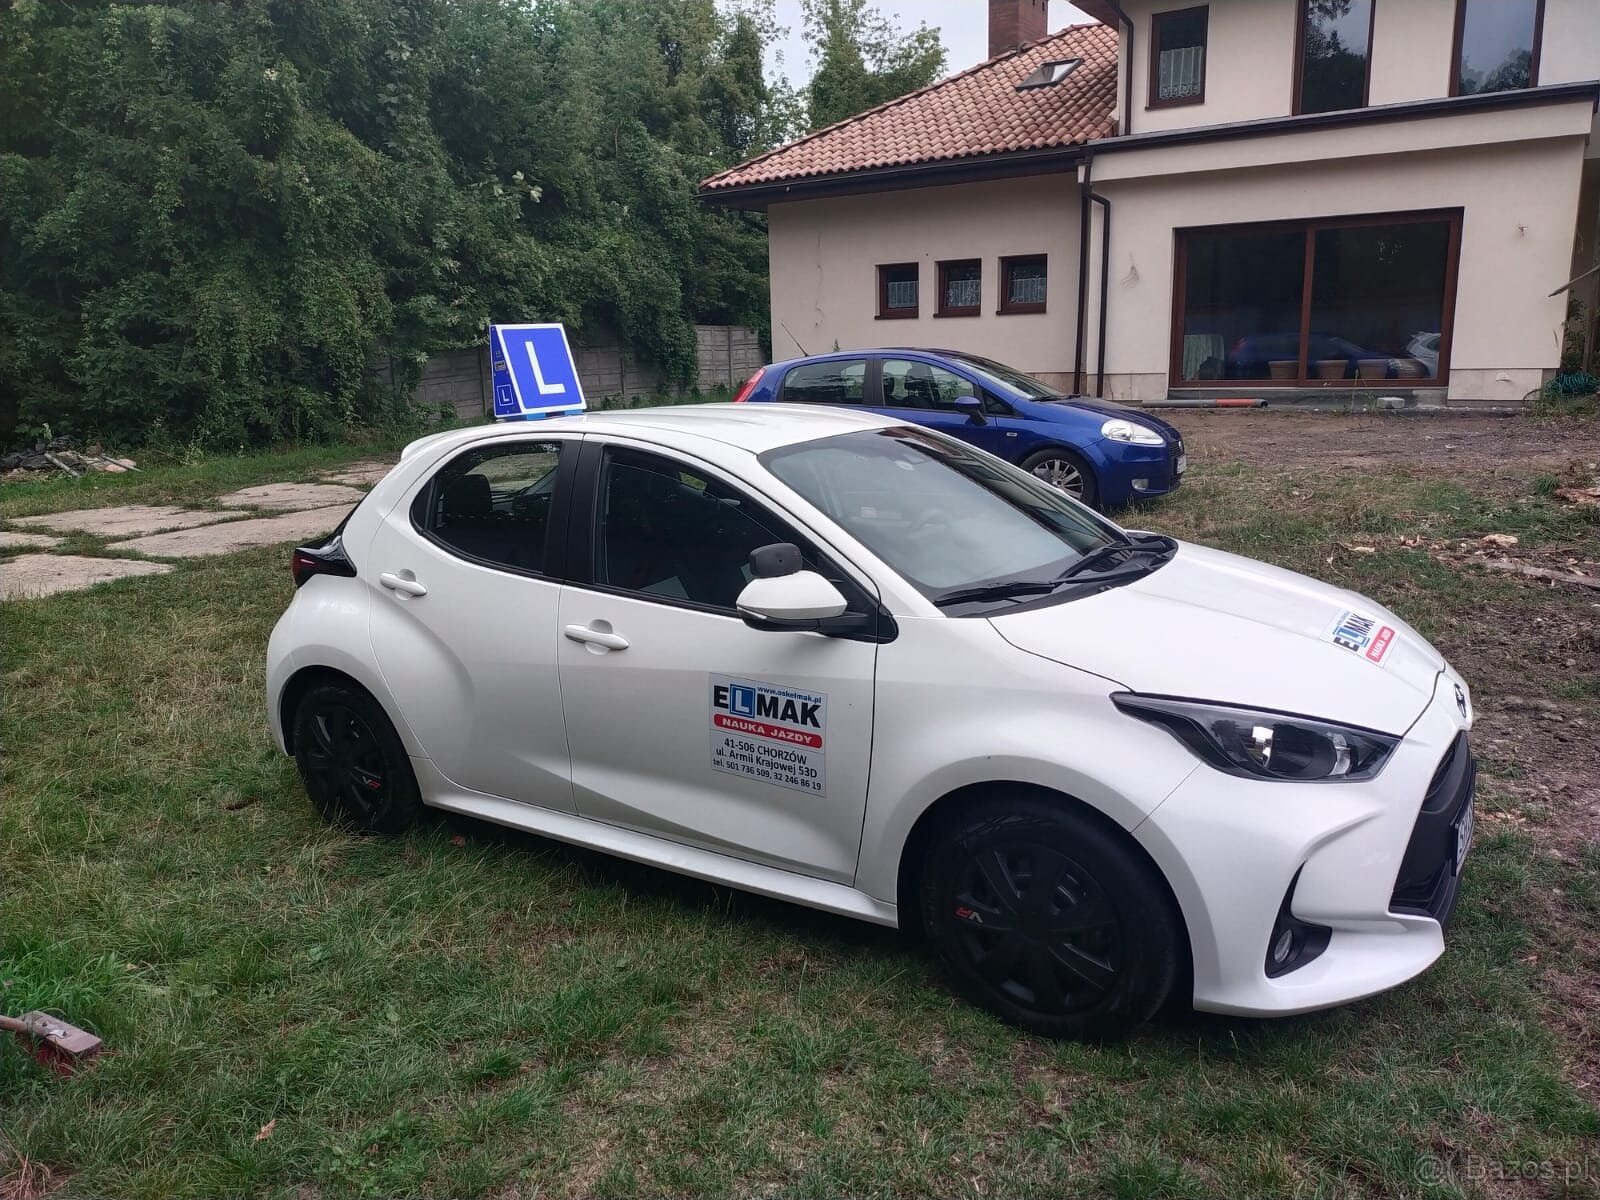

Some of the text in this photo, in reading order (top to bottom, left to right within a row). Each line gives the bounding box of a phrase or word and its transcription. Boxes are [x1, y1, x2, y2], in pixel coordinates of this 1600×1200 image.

[525, 341, 566, 395] L
[501, 389, 509, 402] L
[713, 684, 821, 728] ELMAK
[722, 718, 813, 744] NAUKA JAZDY
[716, 748, 818, 779] ul. Armii Krajowej 53D
[724, 738, 808, 765] 41-506 CHORZÓW
[713, 758, 725, 768] tel.
[726, 761, 739, 771] 501
[741, 765, 755, 775] 736
[773, 772, 783, 781] 32
[785, 775, 799, 785] 246
[812, 781, 822, 791] 19
